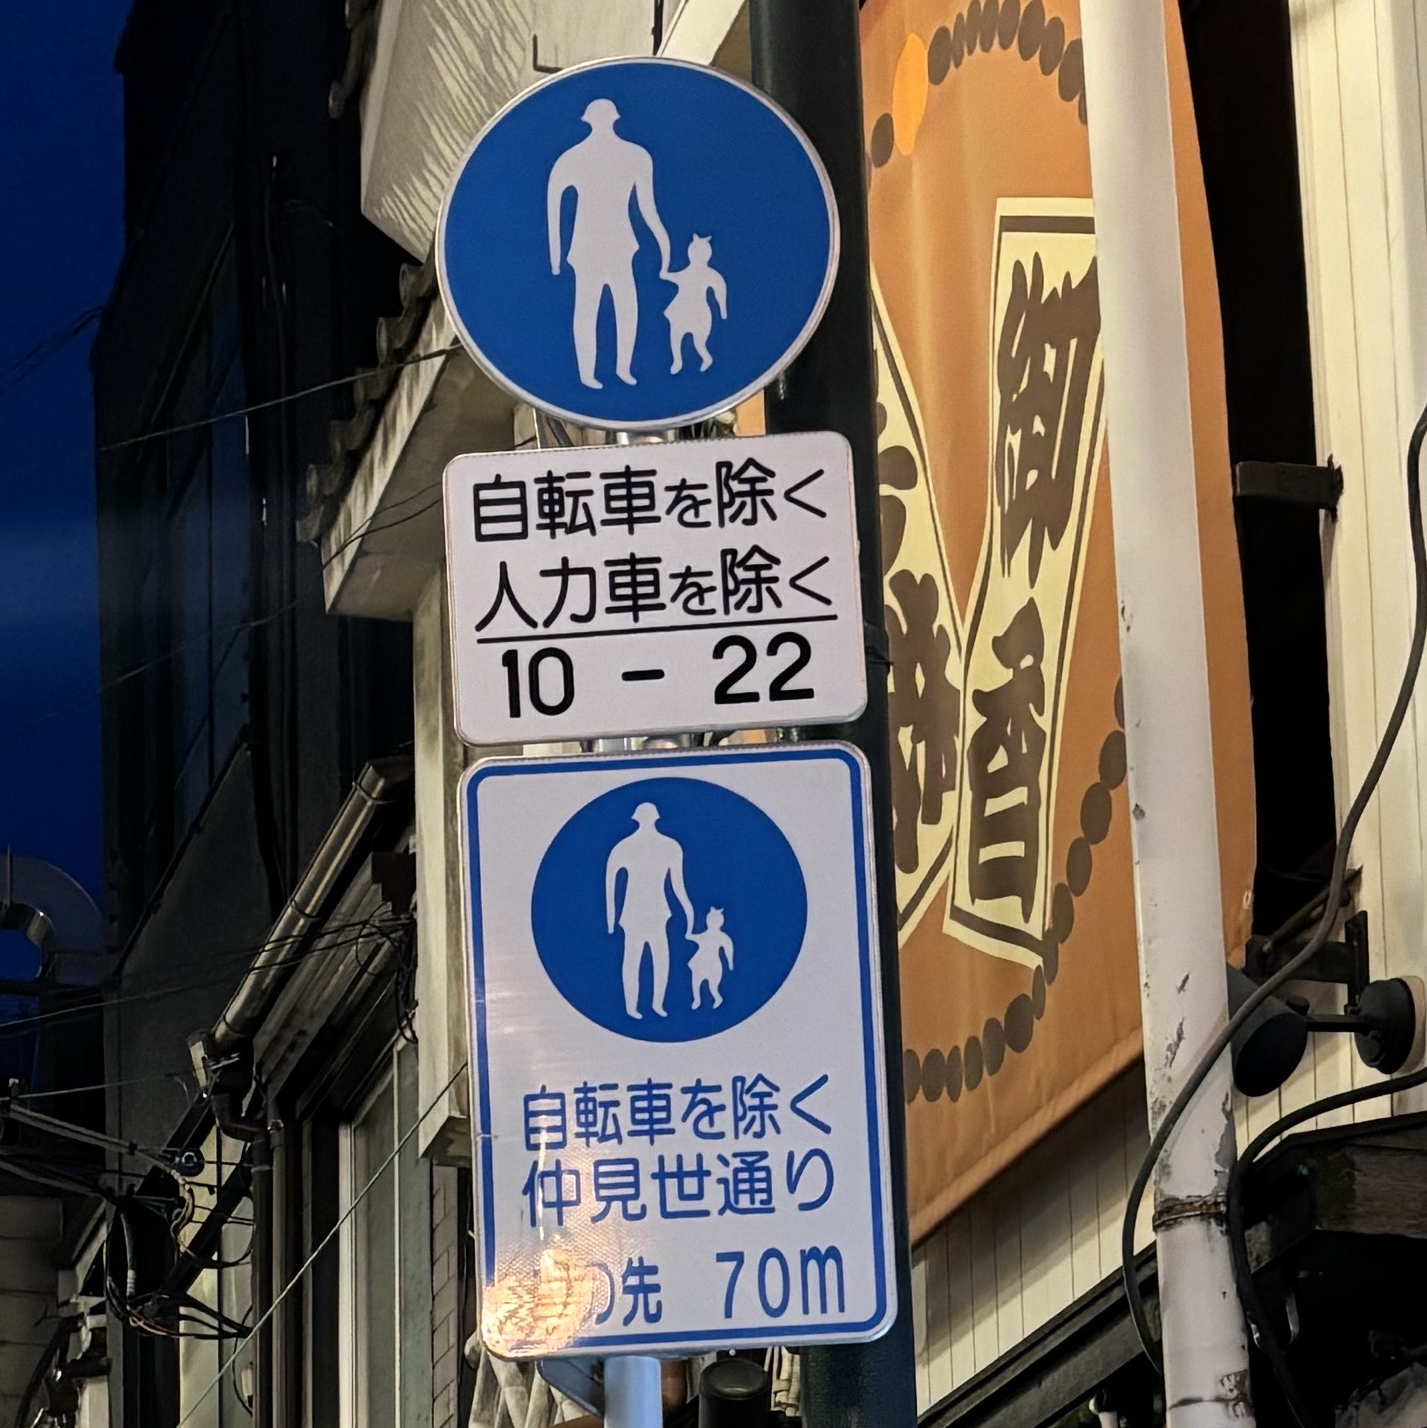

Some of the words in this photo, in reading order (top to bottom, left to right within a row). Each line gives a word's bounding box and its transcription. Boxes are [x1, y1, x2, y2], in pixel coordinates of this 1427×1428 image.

[474, 458, 825, 543] 自転車を除く
[476, 548, 832, 632] 人力車を除く
[502, 648, 573, 718] 10
[712, 634, 814, 705] 22
[523, 1073, 832, 1150] 自転車を除く
[522, 1147, 835, 1226] 仲見世通り
[716, 1244, 845, 1319] 70m
